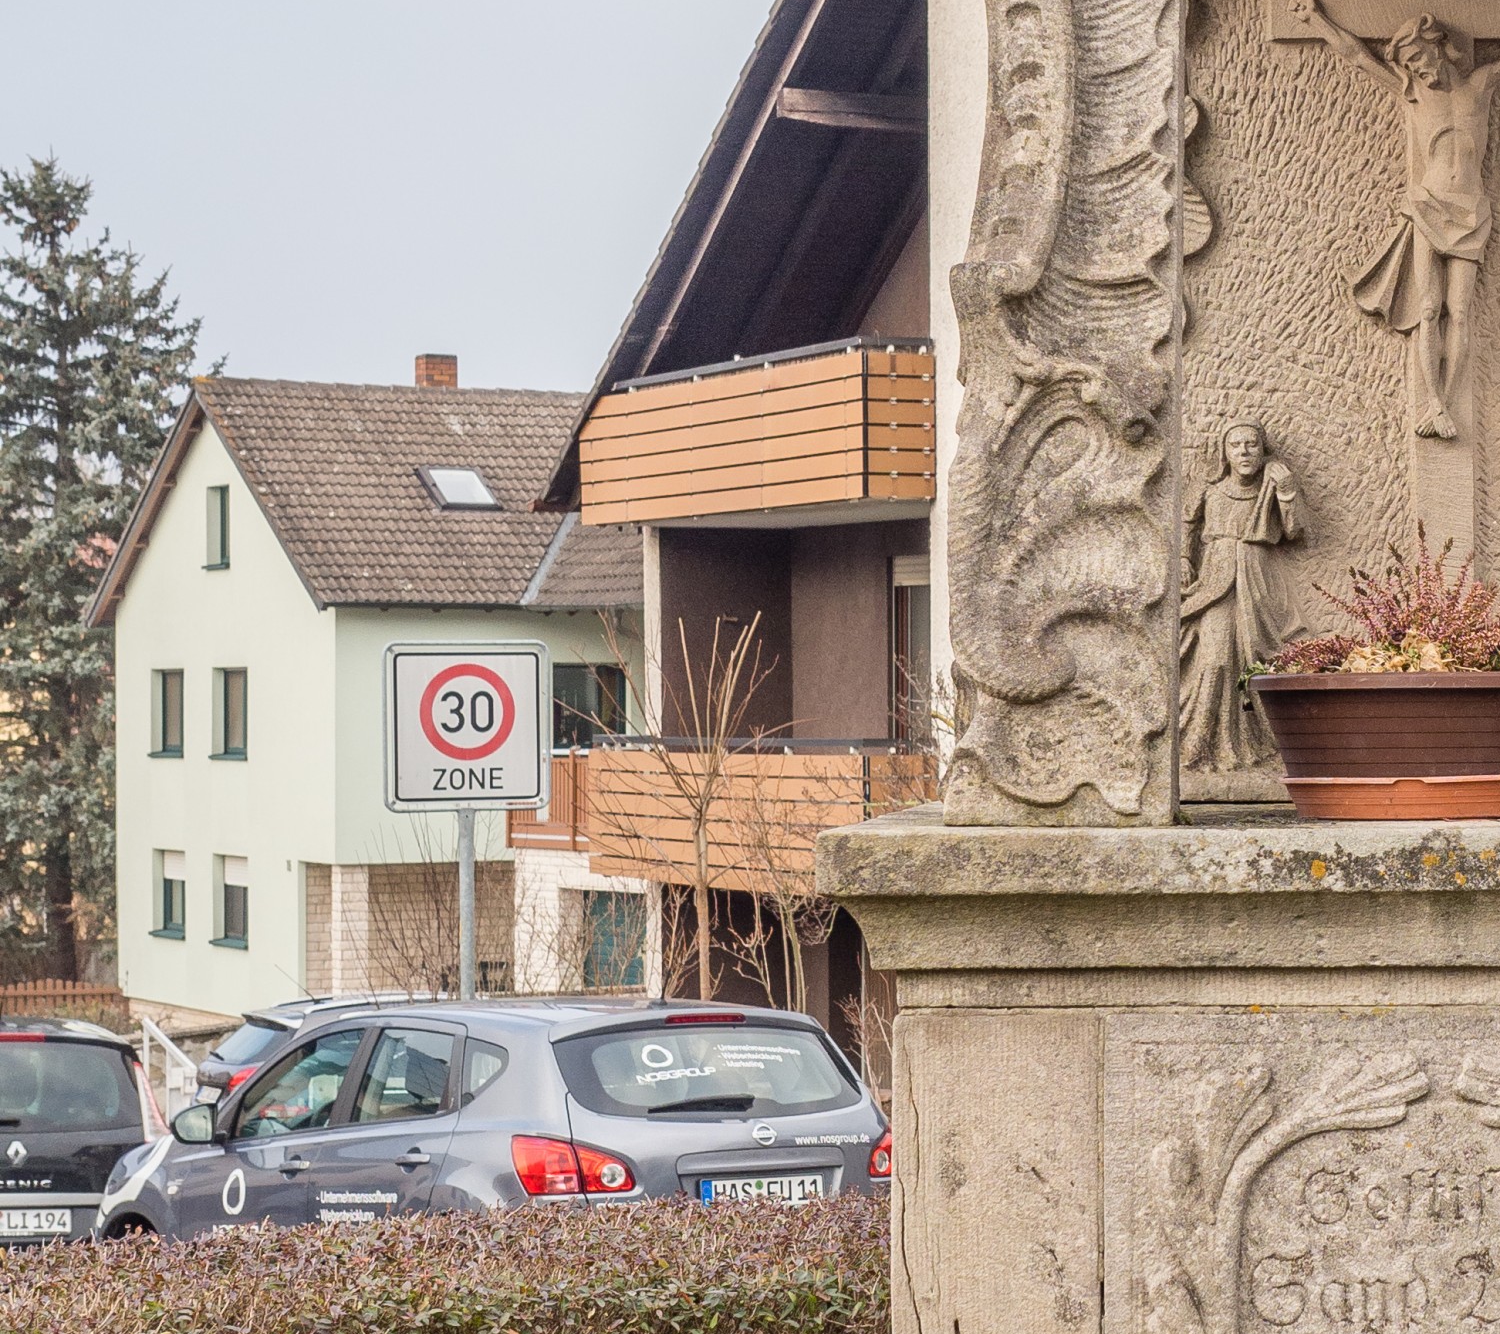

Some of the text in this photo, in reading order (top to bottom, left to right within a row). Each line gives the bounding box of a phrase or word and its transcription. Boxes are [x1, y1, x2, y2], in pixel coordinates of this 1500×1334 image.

[440, 690, 494, 733] 30
[432, 767, 504, 791] ZONE
[635, 1066, 717, 1084] NOSGROUP
[794, 1132, 870, 1145] www.nosgroup.de
[0, 1179, 52, 1188] ENIC
[714, 1182, 752, 1201] HAS
[797, 1178, 818, 1201] 11
[7, 1212, 67, 1230] LI 194
